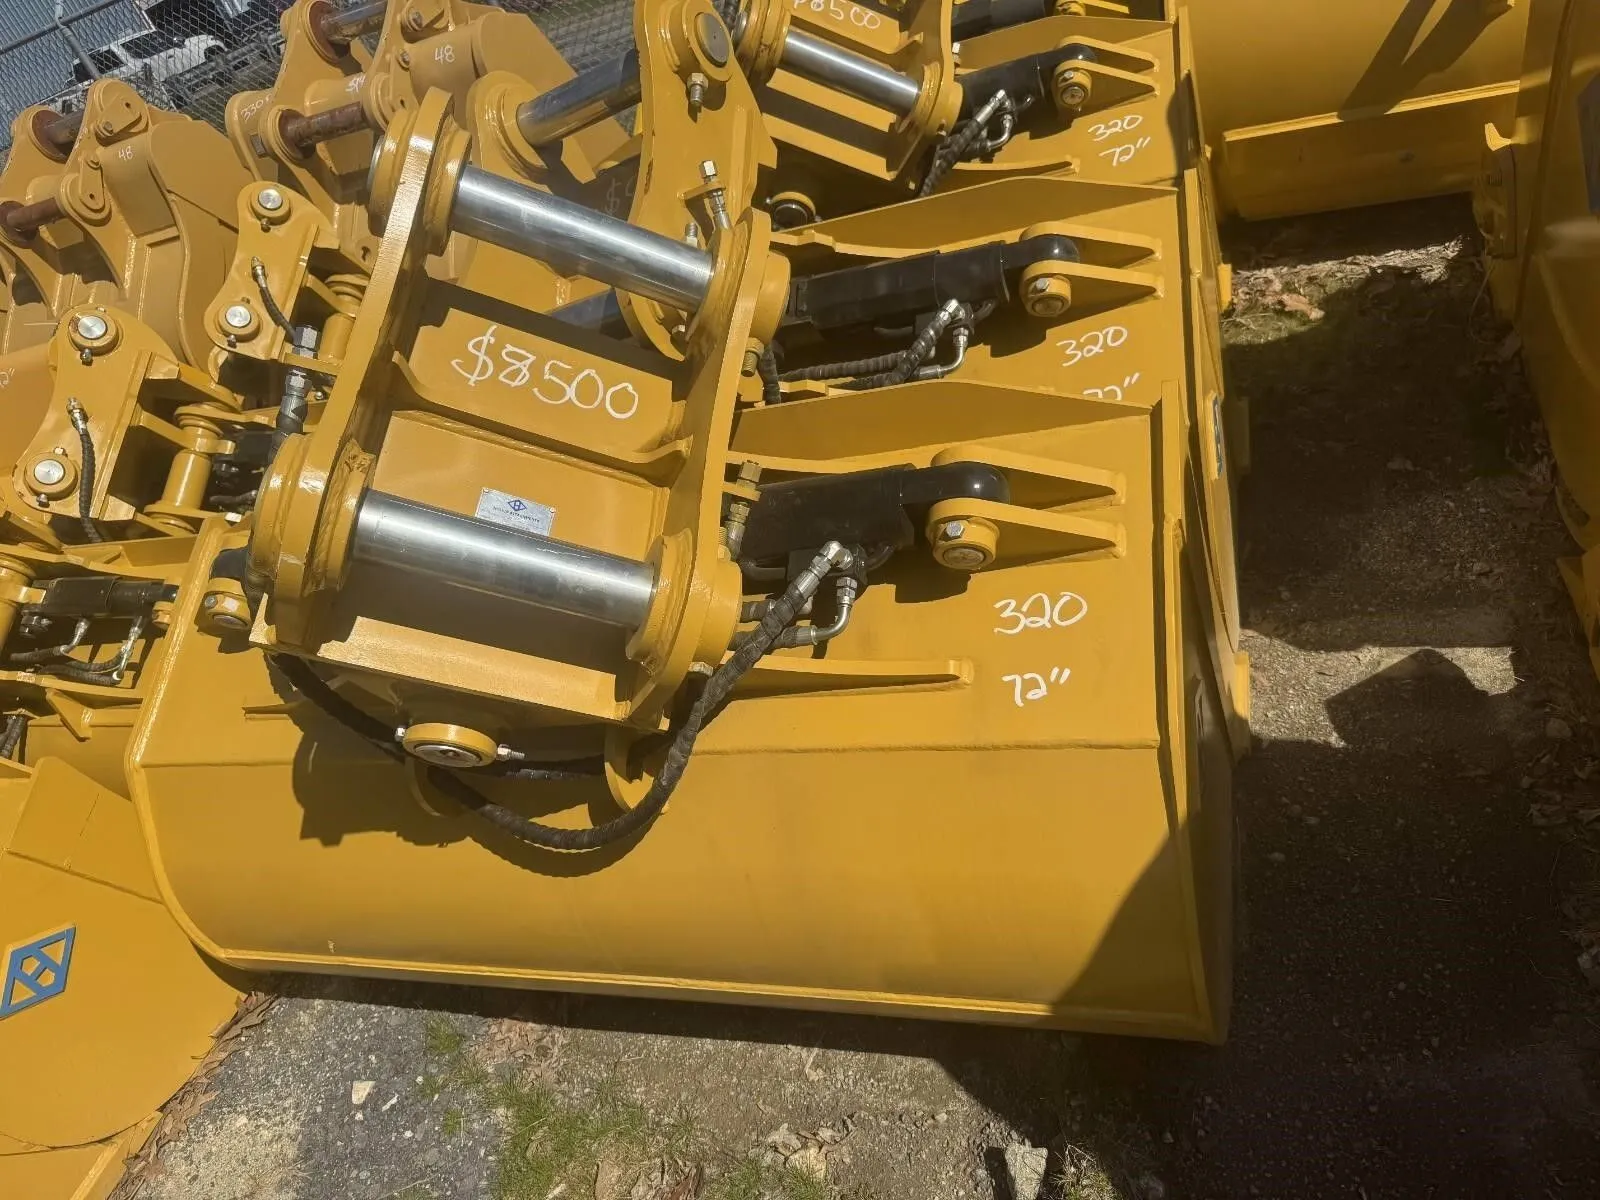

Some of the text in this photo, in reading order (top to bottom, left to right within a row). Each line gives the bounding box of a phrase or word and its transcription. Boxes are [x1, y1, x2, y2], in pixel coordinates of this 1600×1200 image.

[794, 0, 881, 29] 8500
[434, 44, 455, 64] 48
[1087, 114, 1144, 141] 320
[118, 145, 133, 161] 48
[1098, 136, 1151, 167] 72"
[1056, 326, 1128, 367] 320
[450, 325, 639, 420] $8500
[993, 591, 1088, 634] 320
[1002, 666, 1071, 707] 72"
